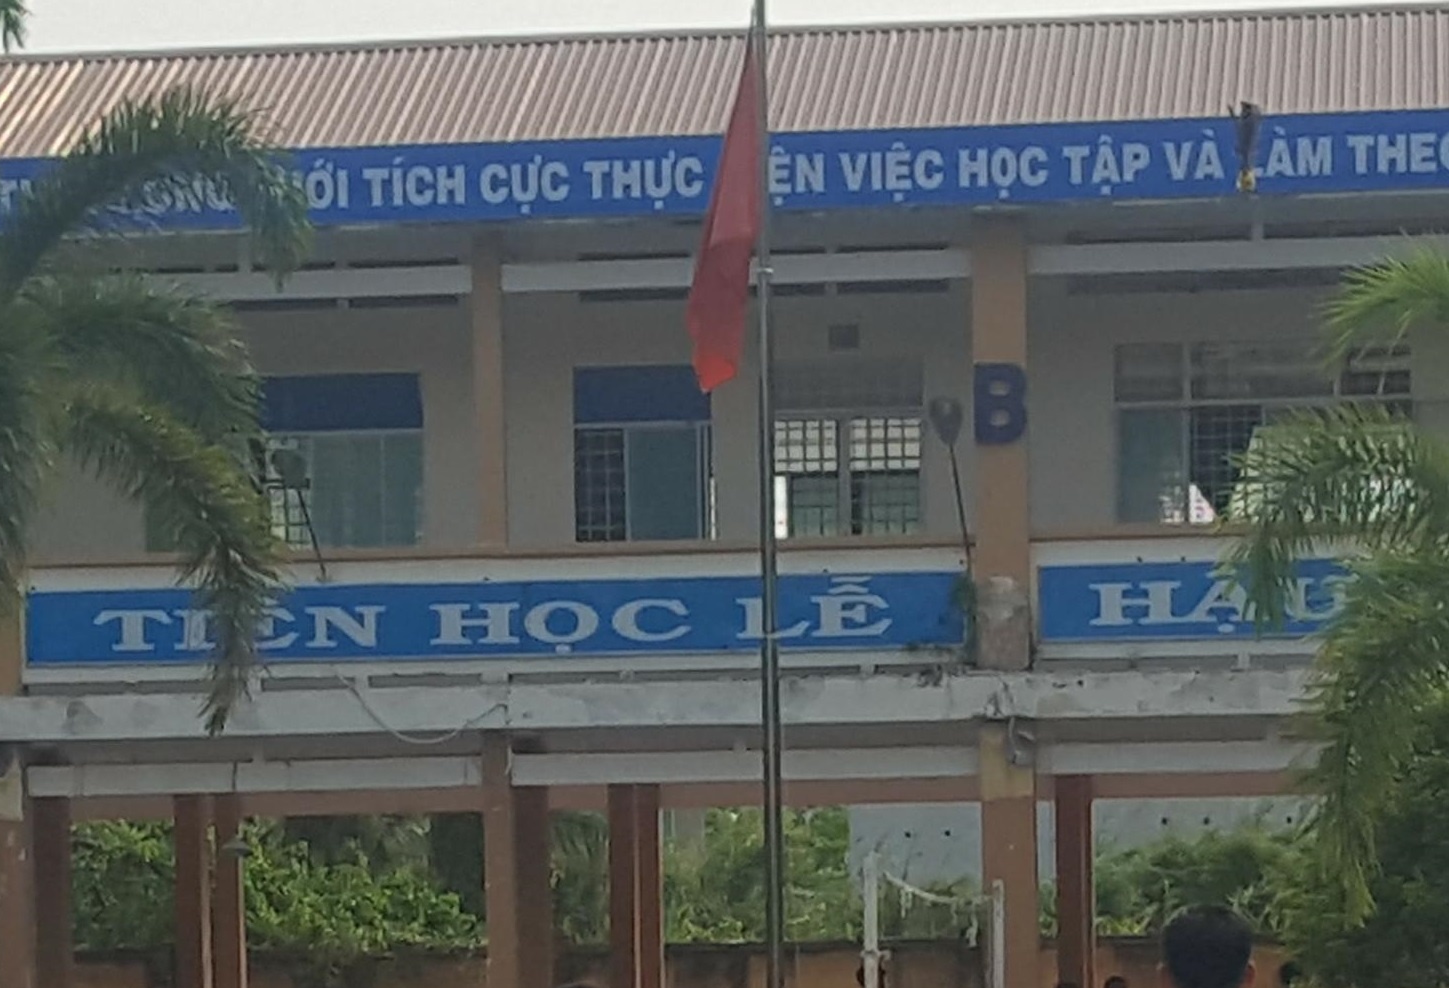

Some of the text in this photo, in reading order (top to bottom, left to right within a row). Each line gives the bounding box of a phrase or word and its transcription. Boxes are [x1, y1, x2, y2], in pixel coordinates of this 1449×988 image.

[363, 155, 469, 208] TÍCH
[480, 154, 570, 215] CỰC
[583, 150, 704, 211] THỰC
[768, 145, 826, 206] ỆN
[838, 141, 945, 202] VIỆC
[958, 146, 1049, 199] HỌC
[1063, 134, 1150, 196] TẬP
[1163, 128, 1225, 181] VÀ
[973, 362, 1028, 445] B
[429, 597, 693, 654] HỌC
[735, 575, 893, 641] LỄ
